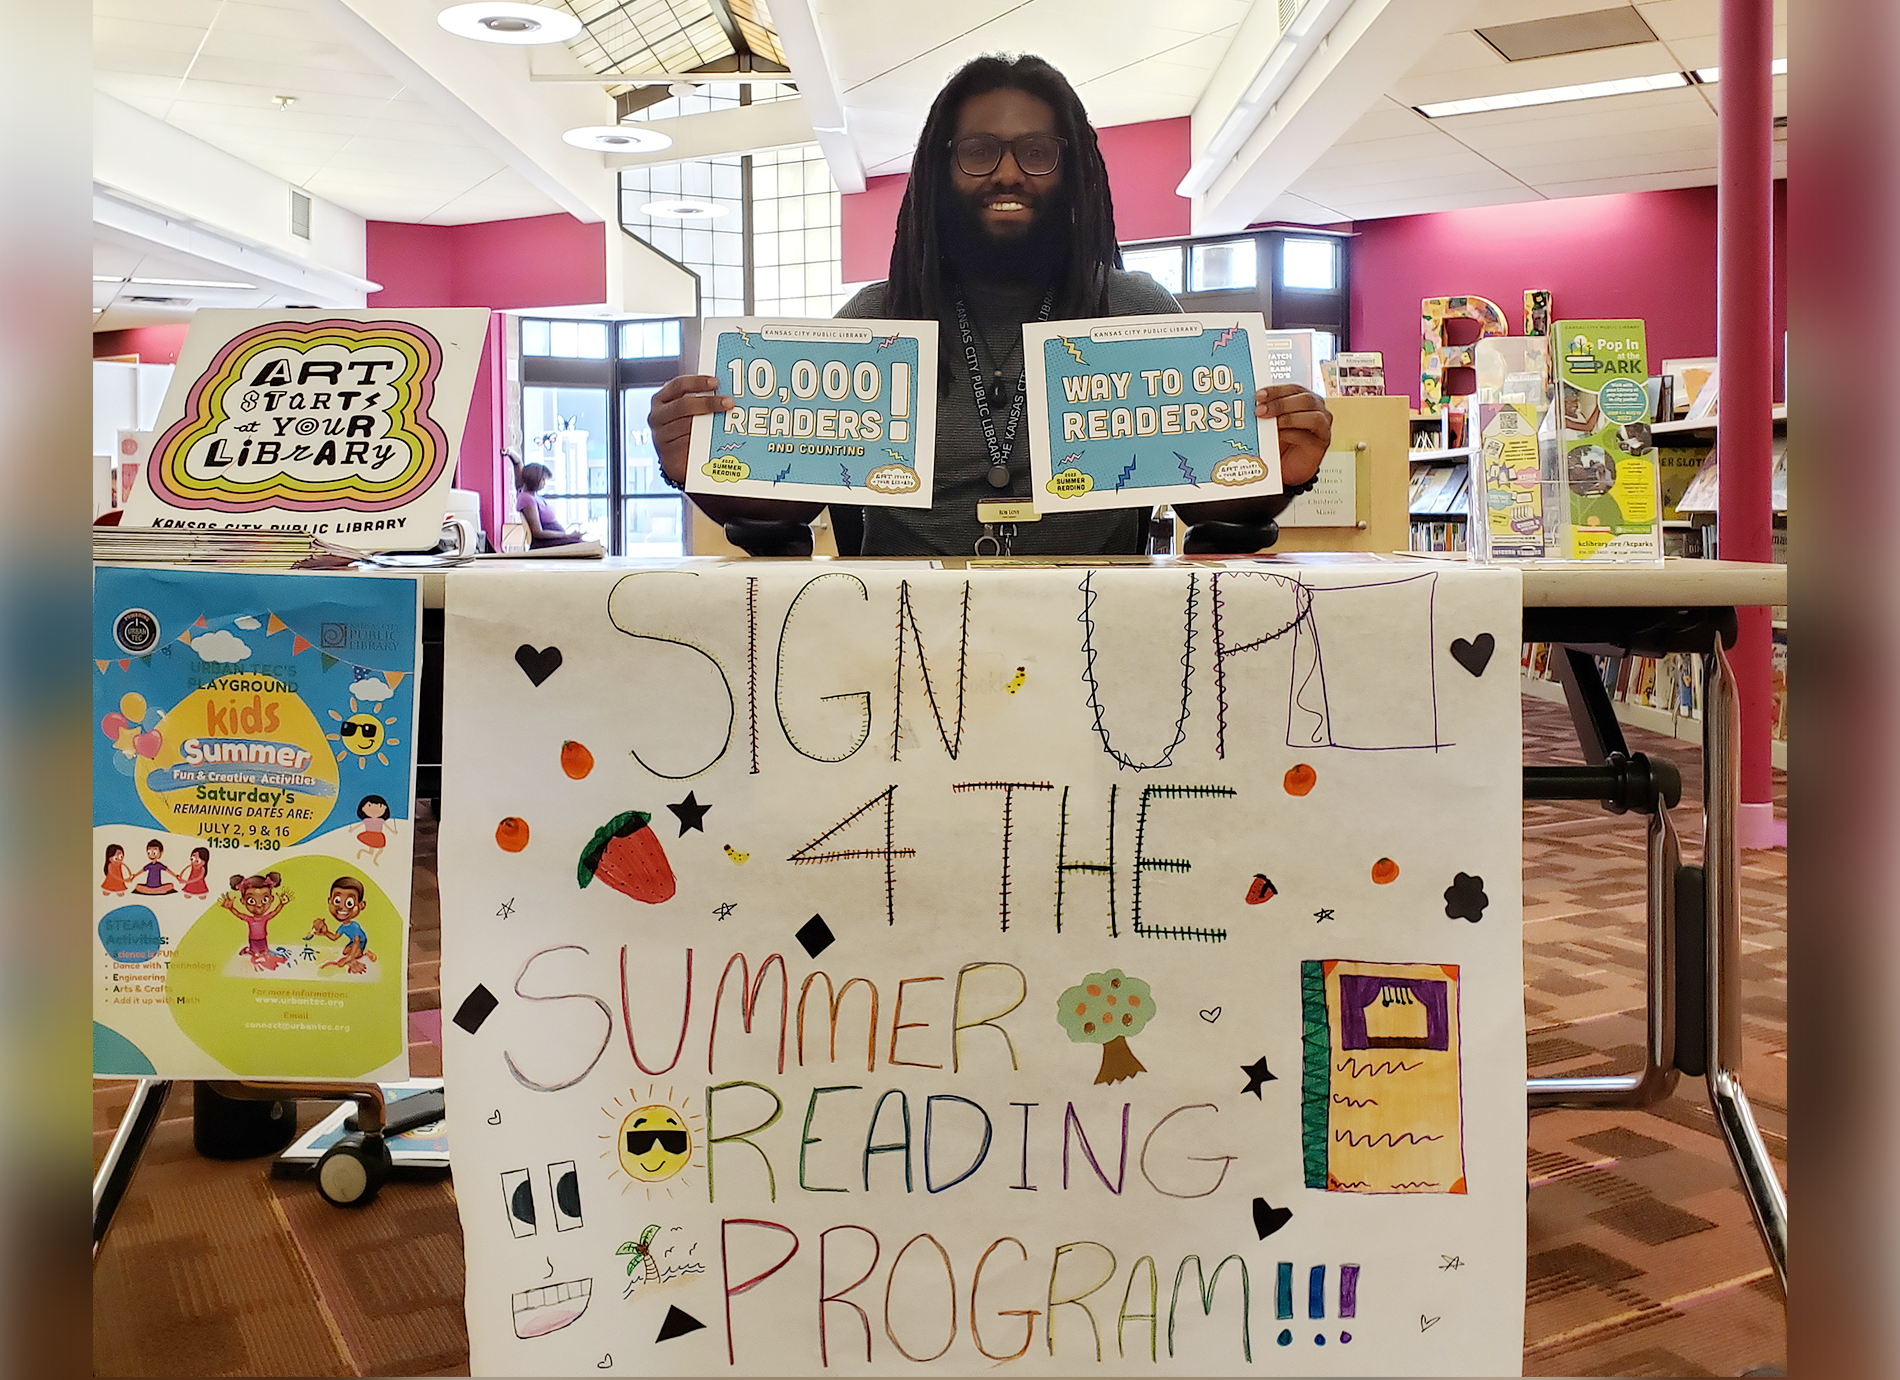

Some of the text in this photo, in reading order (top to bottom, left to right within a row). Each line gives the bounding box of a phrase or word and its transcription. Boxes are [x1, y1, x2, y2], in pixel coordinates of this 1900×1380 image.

[955, 300, 973, 344] KANSAS
[1094, 330, 1122, 338] KANSAS
[1143, 327, 1167, 335] PUBLIC
[1597, 338, 1639, 353] Pop In
[964, 345, 980, 373] CITY
[1594, 359, 1643, 374] PARK
[249, 358, 393, 387] ART
[728, 357, 882, 404] 10,000
[1061, 363, 1244, 404] WAY TO GO,
[971, 374, 990, 418] PUBLIC
[1004, 394, 1024, 440] KANSAS
[1062, 398, 1246, 443] READERS!
[233, 420, 262, 433] at
[768, 443, 866, 457] AND COUNTING
[981, 417, 1001, 466] LIBRARY
[999, 442, 1013, 465] THE
[712, 462, 742, 472] SUMMER
[712, 469, 742, 478] READING
[1056, 477, 1086, 485] SUMMER
[1056, 484, 1086, 492] READING
[336, 517, 407, 534] LIBRARY
[187, 677, 299, 693] PLAYGROUND
[606, 571, 974, 783] SIGN
[207, 694, 280, 737] kids
[184, 738, 314, 770] Summer
[173, 769, 316, 786] Fun & Creative Activities
[196, 785, 296, 808] Saturday's
[173, 803, 314, 820] REMAINING DATES ARE:
[197, 822, 290, 837] JULY 2, 9 & 16
[207, 836, 240, 849] 11:30
[254, 838, 281, 851] 1:30
[786, 783, 1238, 943] 4 THE
[113, 962, 141, 970] Dance
[142, 961, 162, 970] with
[112, 973, 166, 983] Engineering
[112, 985, 133, 993] Arts
[135, 985, 142, 993] &
[113, 996, 132, 1005] Add
[142, 997, 154, 1007] up
[503, 944, 1028, 1093] SUMMER
[704, 1079, 1239, 1204] READING
